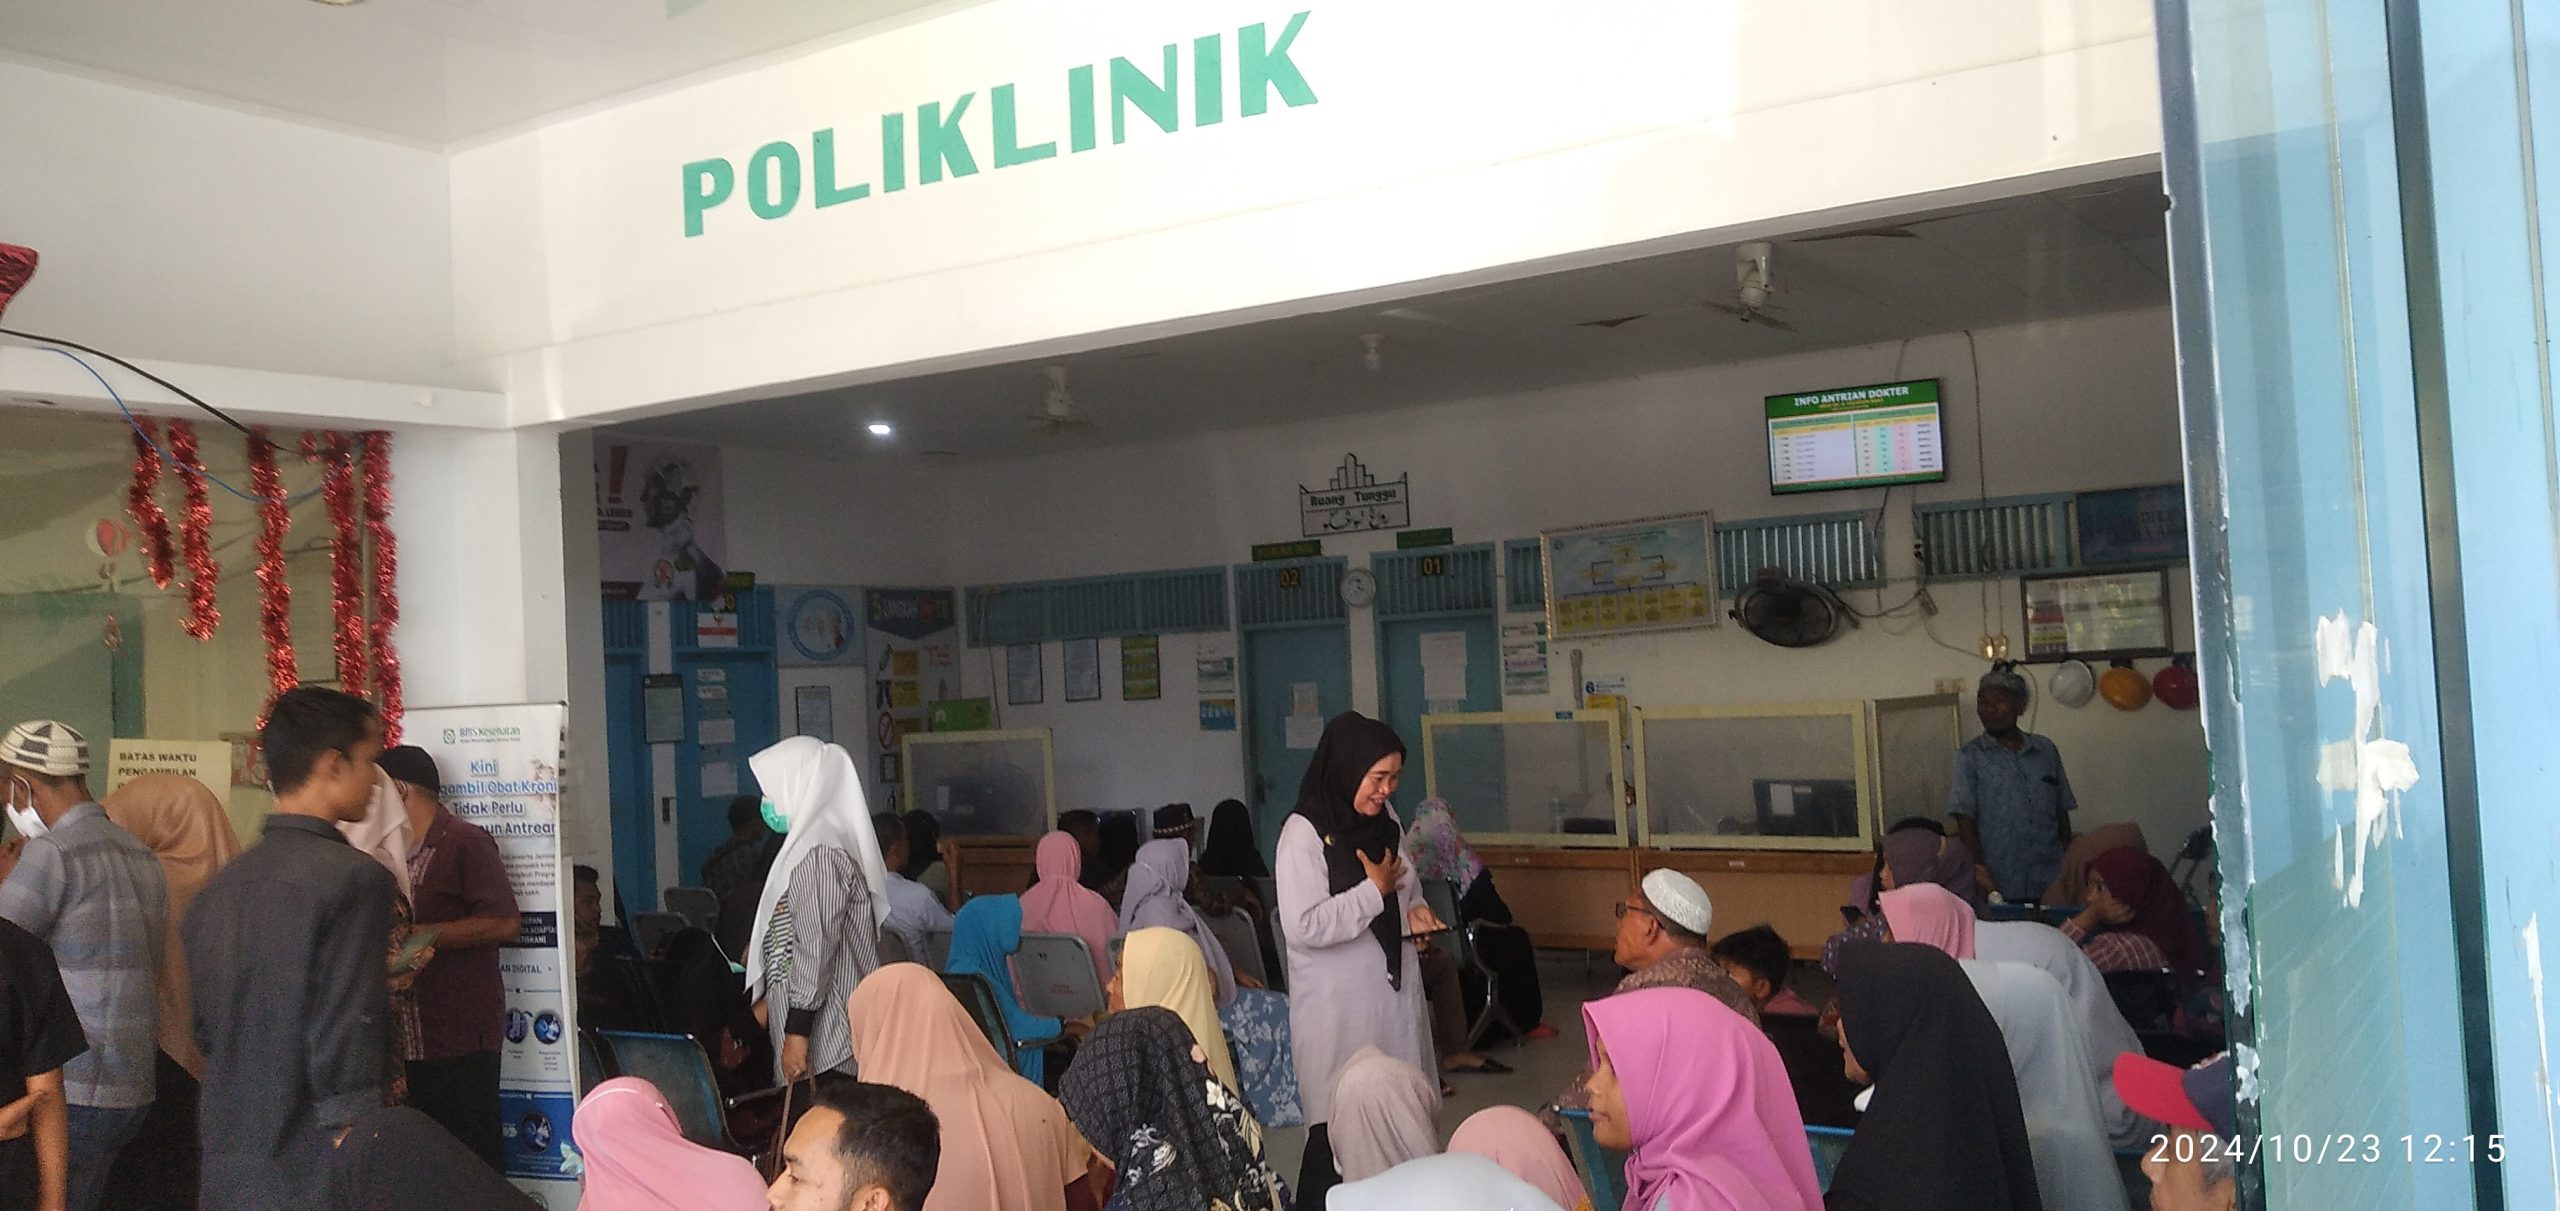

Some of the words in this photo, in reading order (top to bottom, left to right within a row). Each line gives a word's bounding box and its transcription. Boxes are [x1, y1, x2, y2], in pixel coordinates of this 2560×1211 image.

[682, 10, 1319, 238] POLIKLINIK
[1794, 396, 1819, 407] INFO
[1821, 390, 1867, 404] ANTRIAN
[1868, 386, 1909, 400] DOKTER
[1310, 495, 1345, 507] Ruang
[1354, 488, 1396, 502] Tunggu
[1423, 558, 1441, 575] 01
[1280, 569, 1298, 587] 02
[119, 752, 155, 762] BATAS
[158, 753, 197, 762] WAKTU
[470, 760, 497, 774] Kini
[487, 780, 518, 794] Obat
[453, 802, 488, 815] Tidak
[491, 801, 523, 815] Perlu
